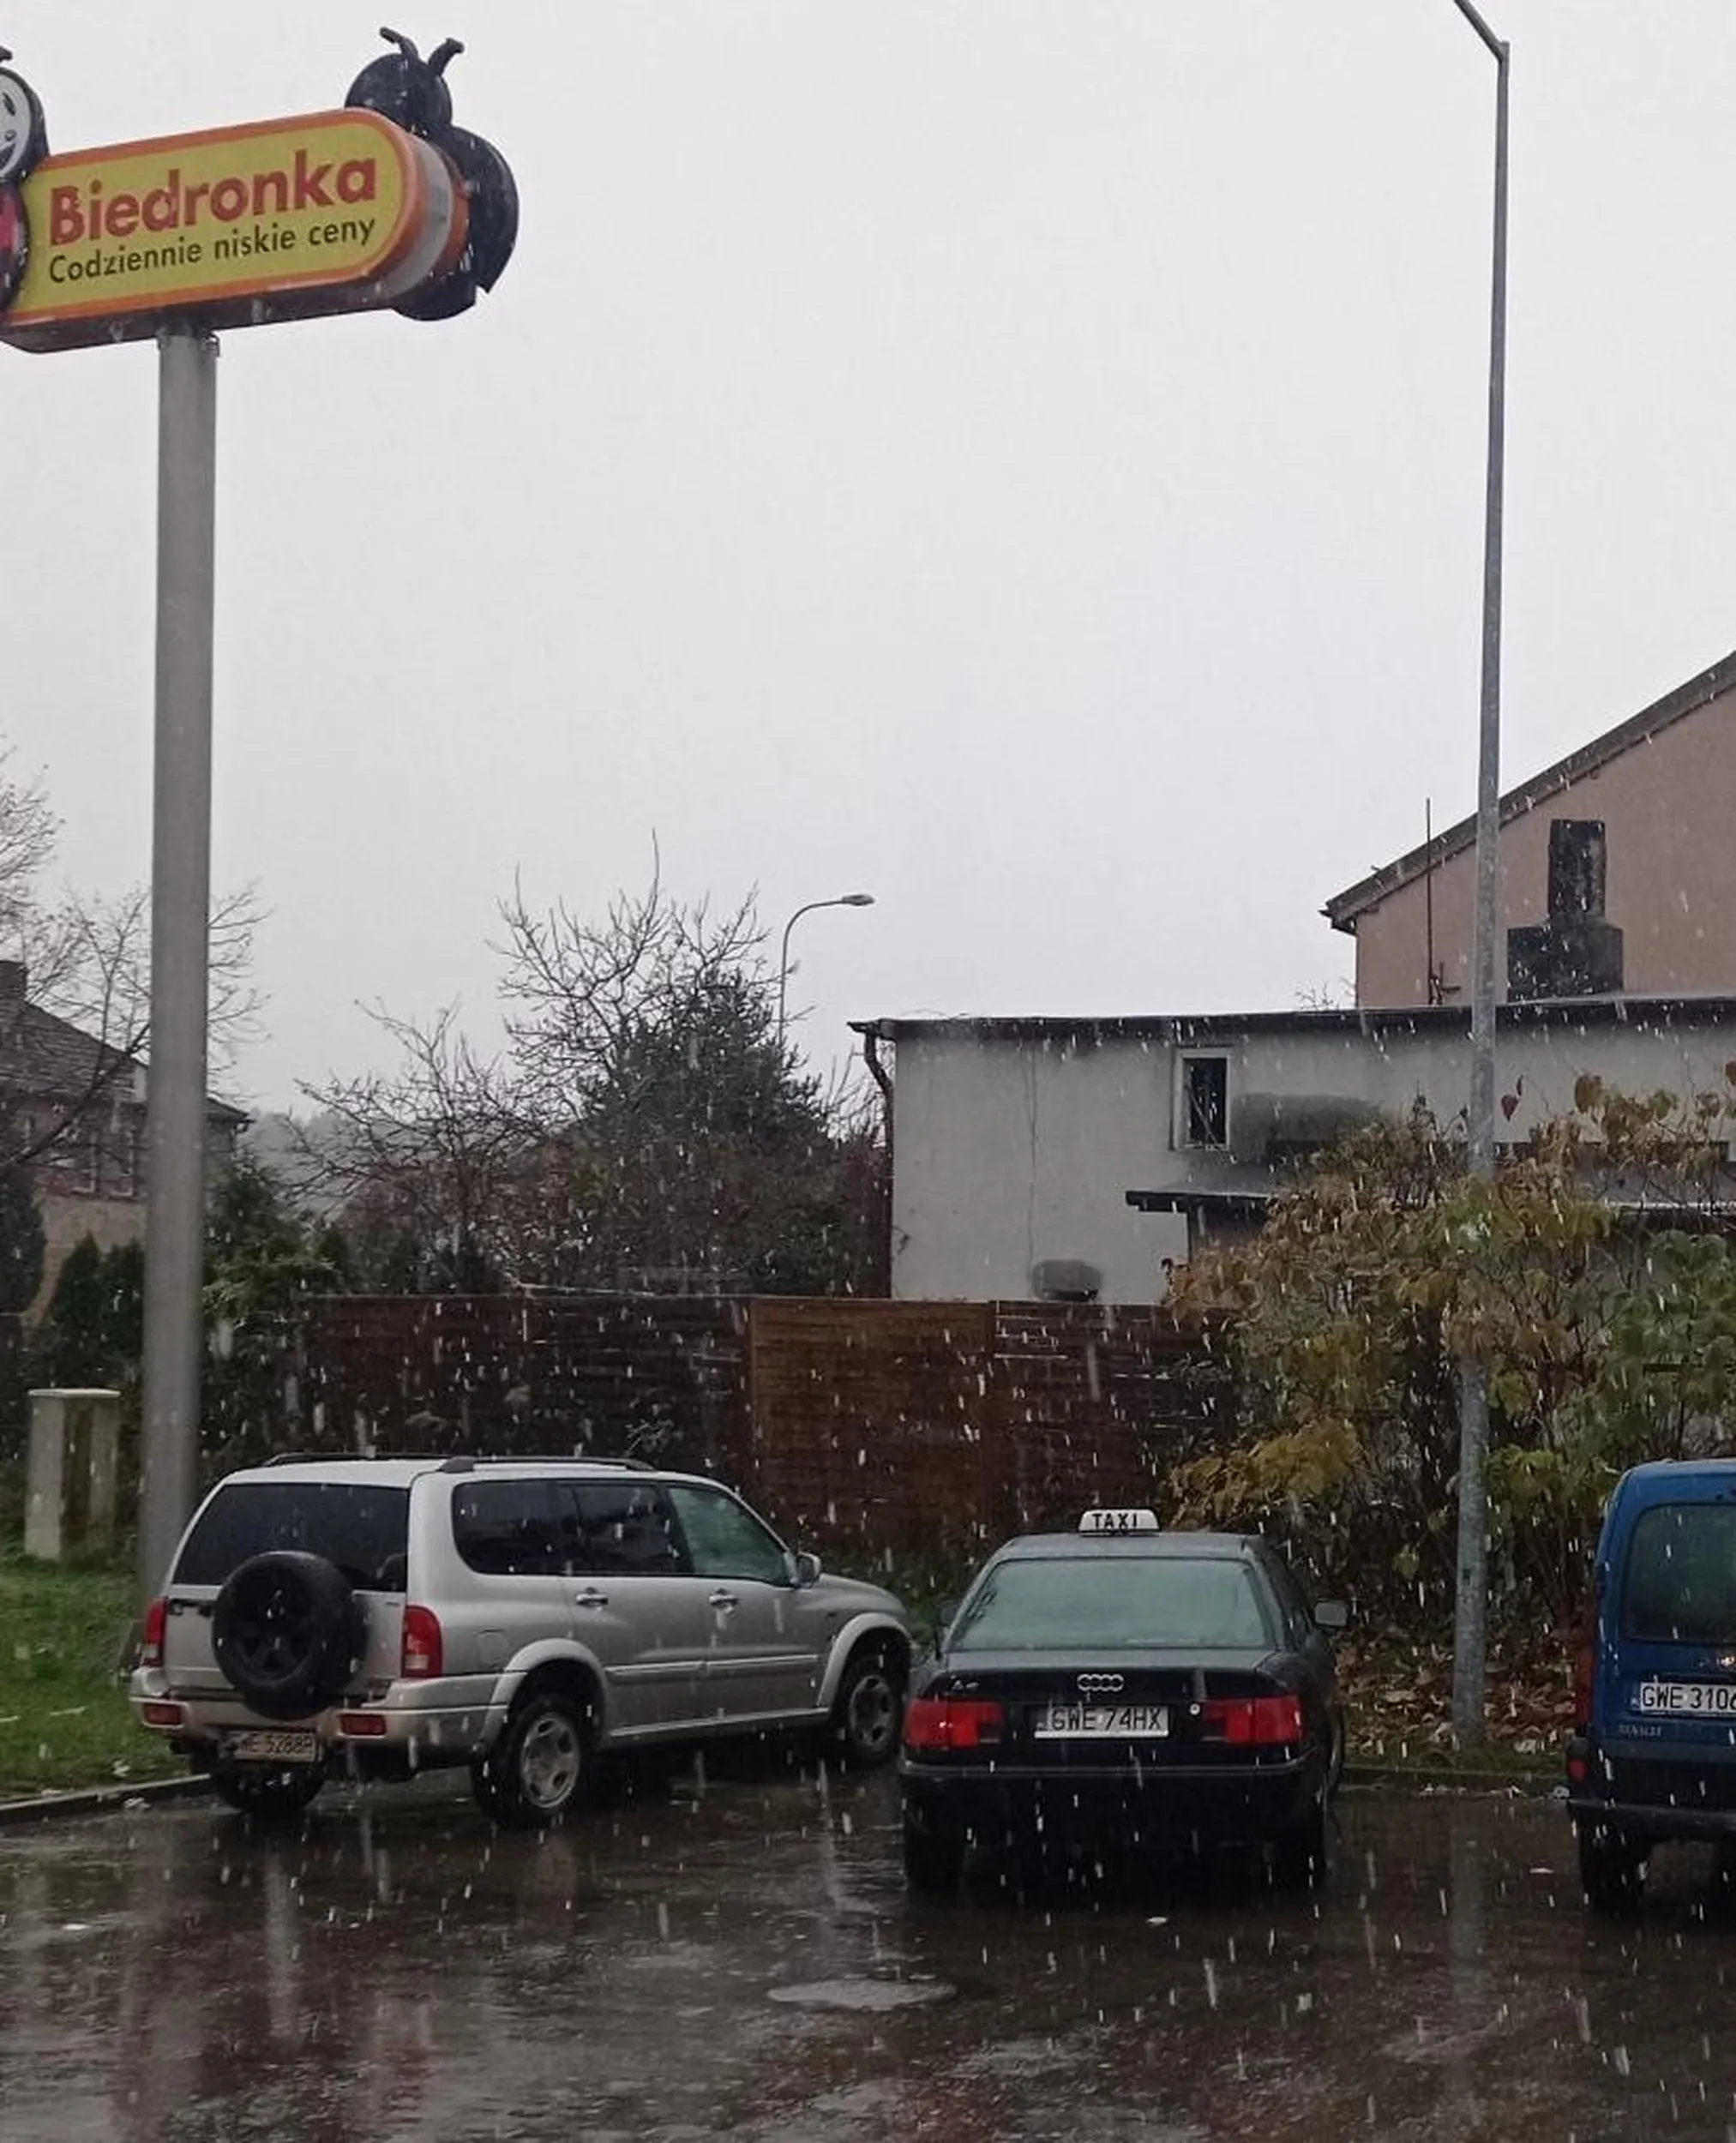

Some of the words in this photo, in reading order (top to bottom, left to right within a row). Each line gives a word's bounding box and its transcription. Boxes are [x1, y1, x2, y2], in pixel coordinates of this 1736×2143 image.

[49, 149, 376, 247] Biedronka
[49, 236, 201, 284] Codziennie
[214, 221, 297, 260] niskie
[309, 218, 375, 247] ceny
[1092, 1513, 1137, 1530] TAXI
[1642, 1685, 1683, 1708] GWE
[1051, 1707, 1096, 1731] GWE
[1104, 1707, 1162, 1731] 74HX
